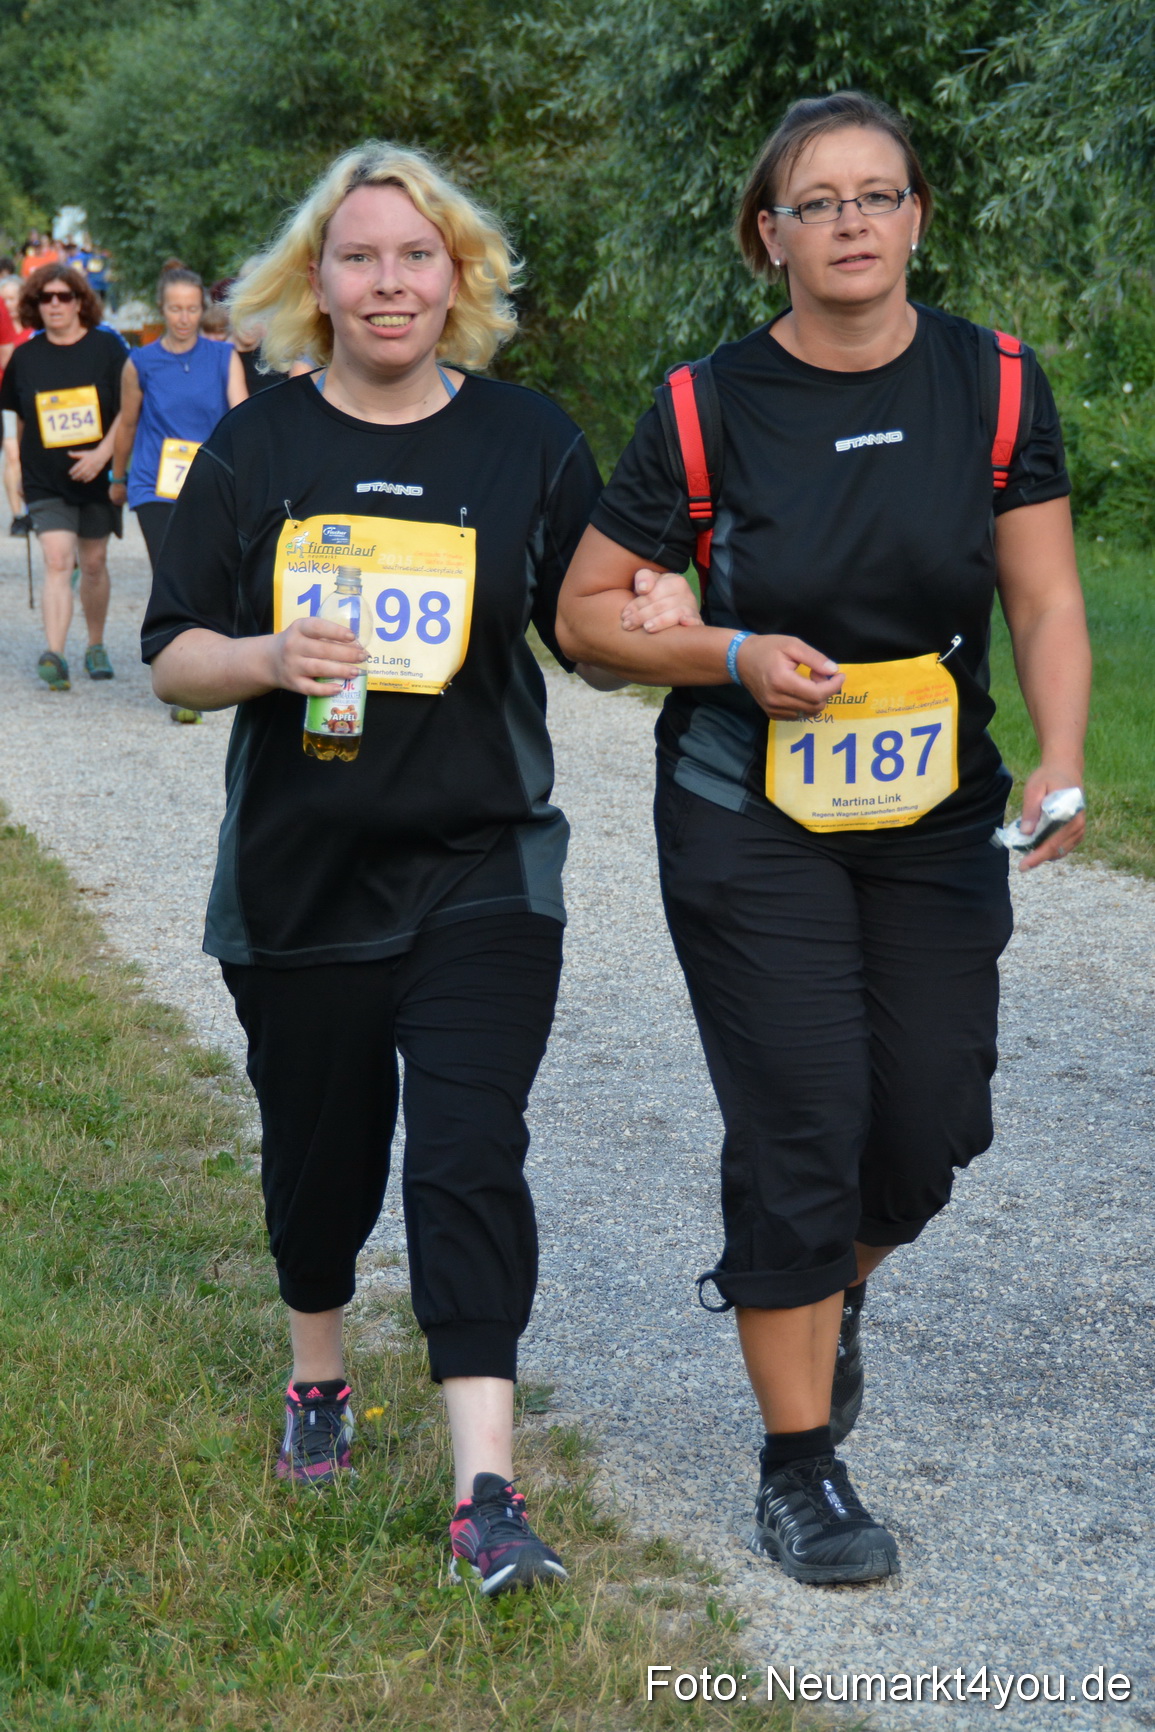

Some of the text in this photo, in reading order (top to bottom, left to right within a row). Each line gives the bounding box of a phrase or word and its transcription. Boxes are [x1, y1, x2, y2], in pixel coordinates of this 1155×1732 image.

[48, 410, 95, 431] 1254
[835, 431, 903, 452] STANNO
[356, 482, 424, 496] STANNO
[308, 542, 377, 557] firmenlauf
[297, 583, 451, 645] 1198
[382, 655, 411, 668] Lang
[827, 692, 869, 704] enlauf
[332, 713, 356, 721] APFEL
[790, 722, 942, 784] 1187
[832, 793, 902, 807] Martina Link
